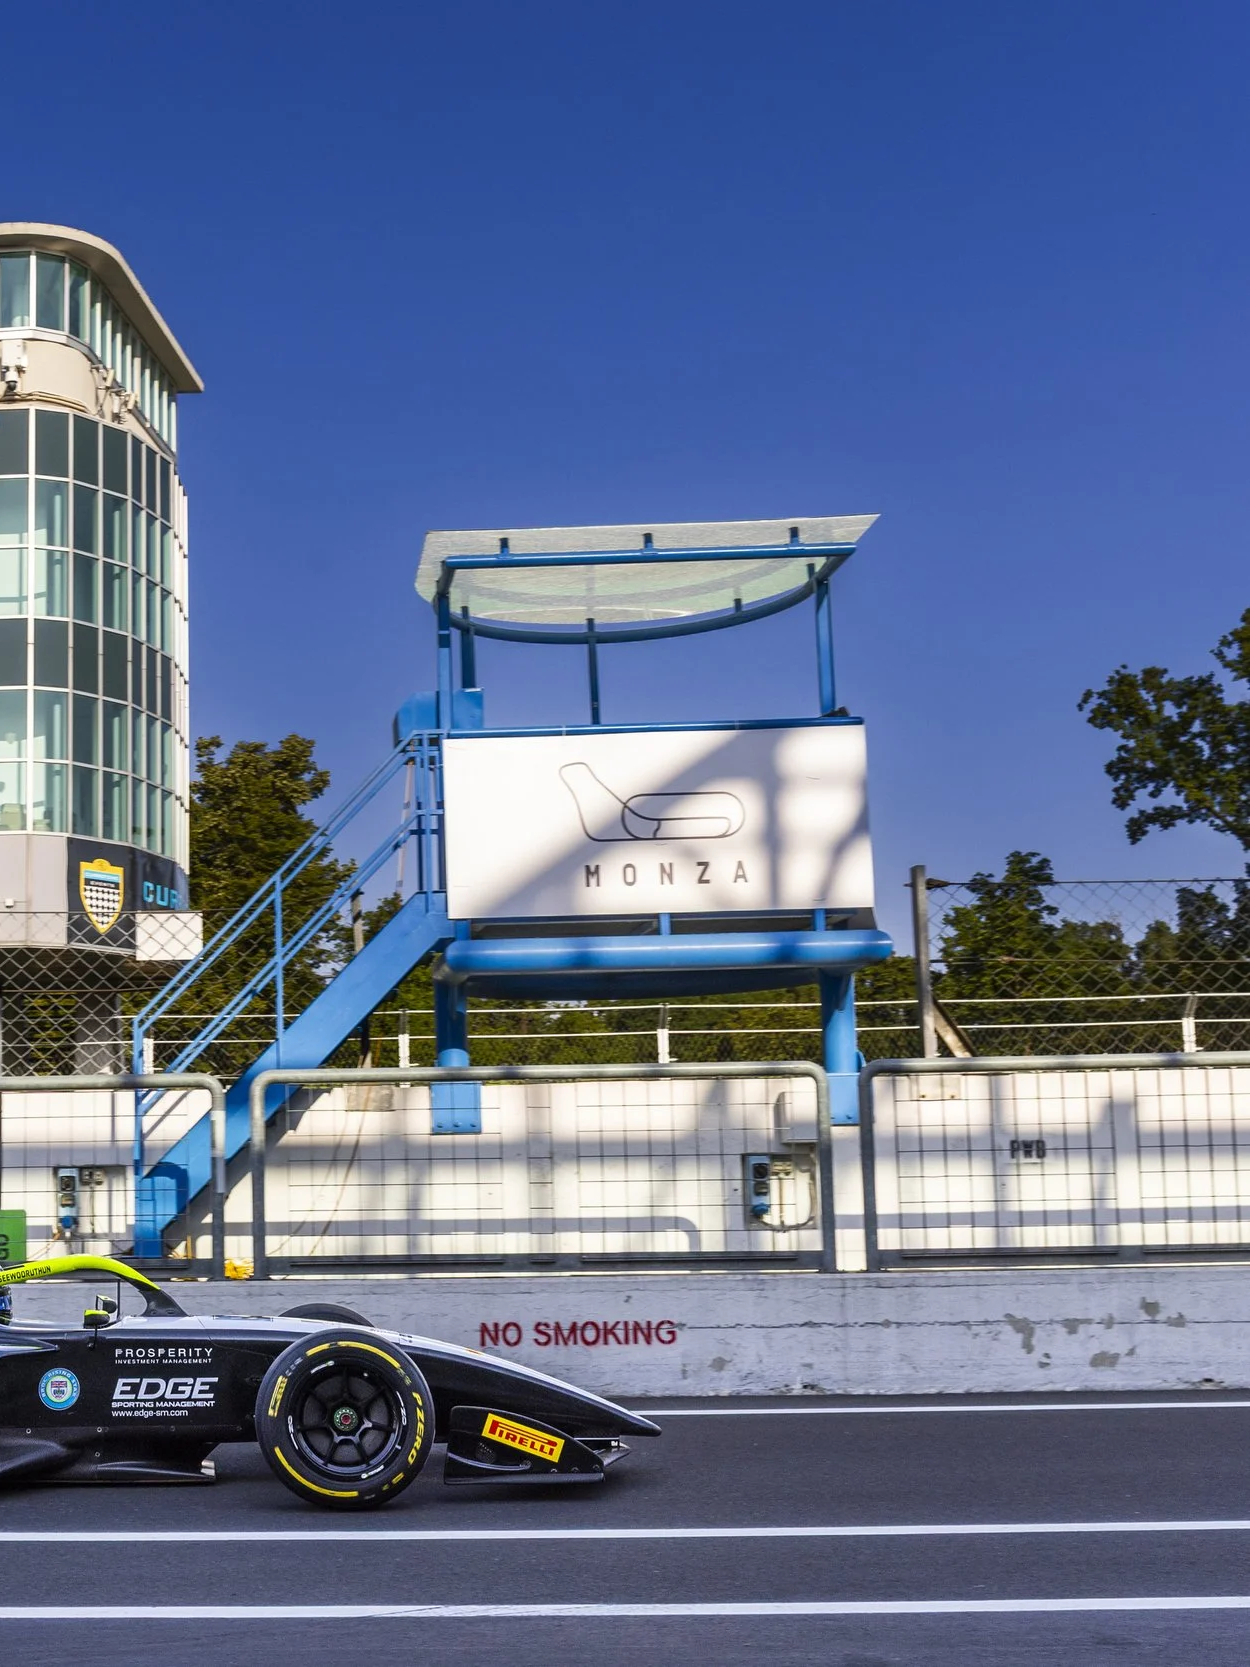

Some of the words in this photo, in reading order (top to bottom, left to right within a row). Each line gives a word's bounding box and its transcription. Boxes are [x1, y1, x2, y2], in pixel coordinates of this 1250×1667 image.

[584, 860, 748, 888] MONZA
[480, 1321, 522, 1347] NO
[533, 1320, 678, 1347] SMOKING
[115, 1348, 213, 1358] PROSPERITY
[112, 1377, 219, 1400] EDGE
[111, 1409, 188, 1419] www.edge-sm.com
[156, 1400, 216, 1408] MANAGEMENT
[488, 1419, 558, 1457] PIRELLI
